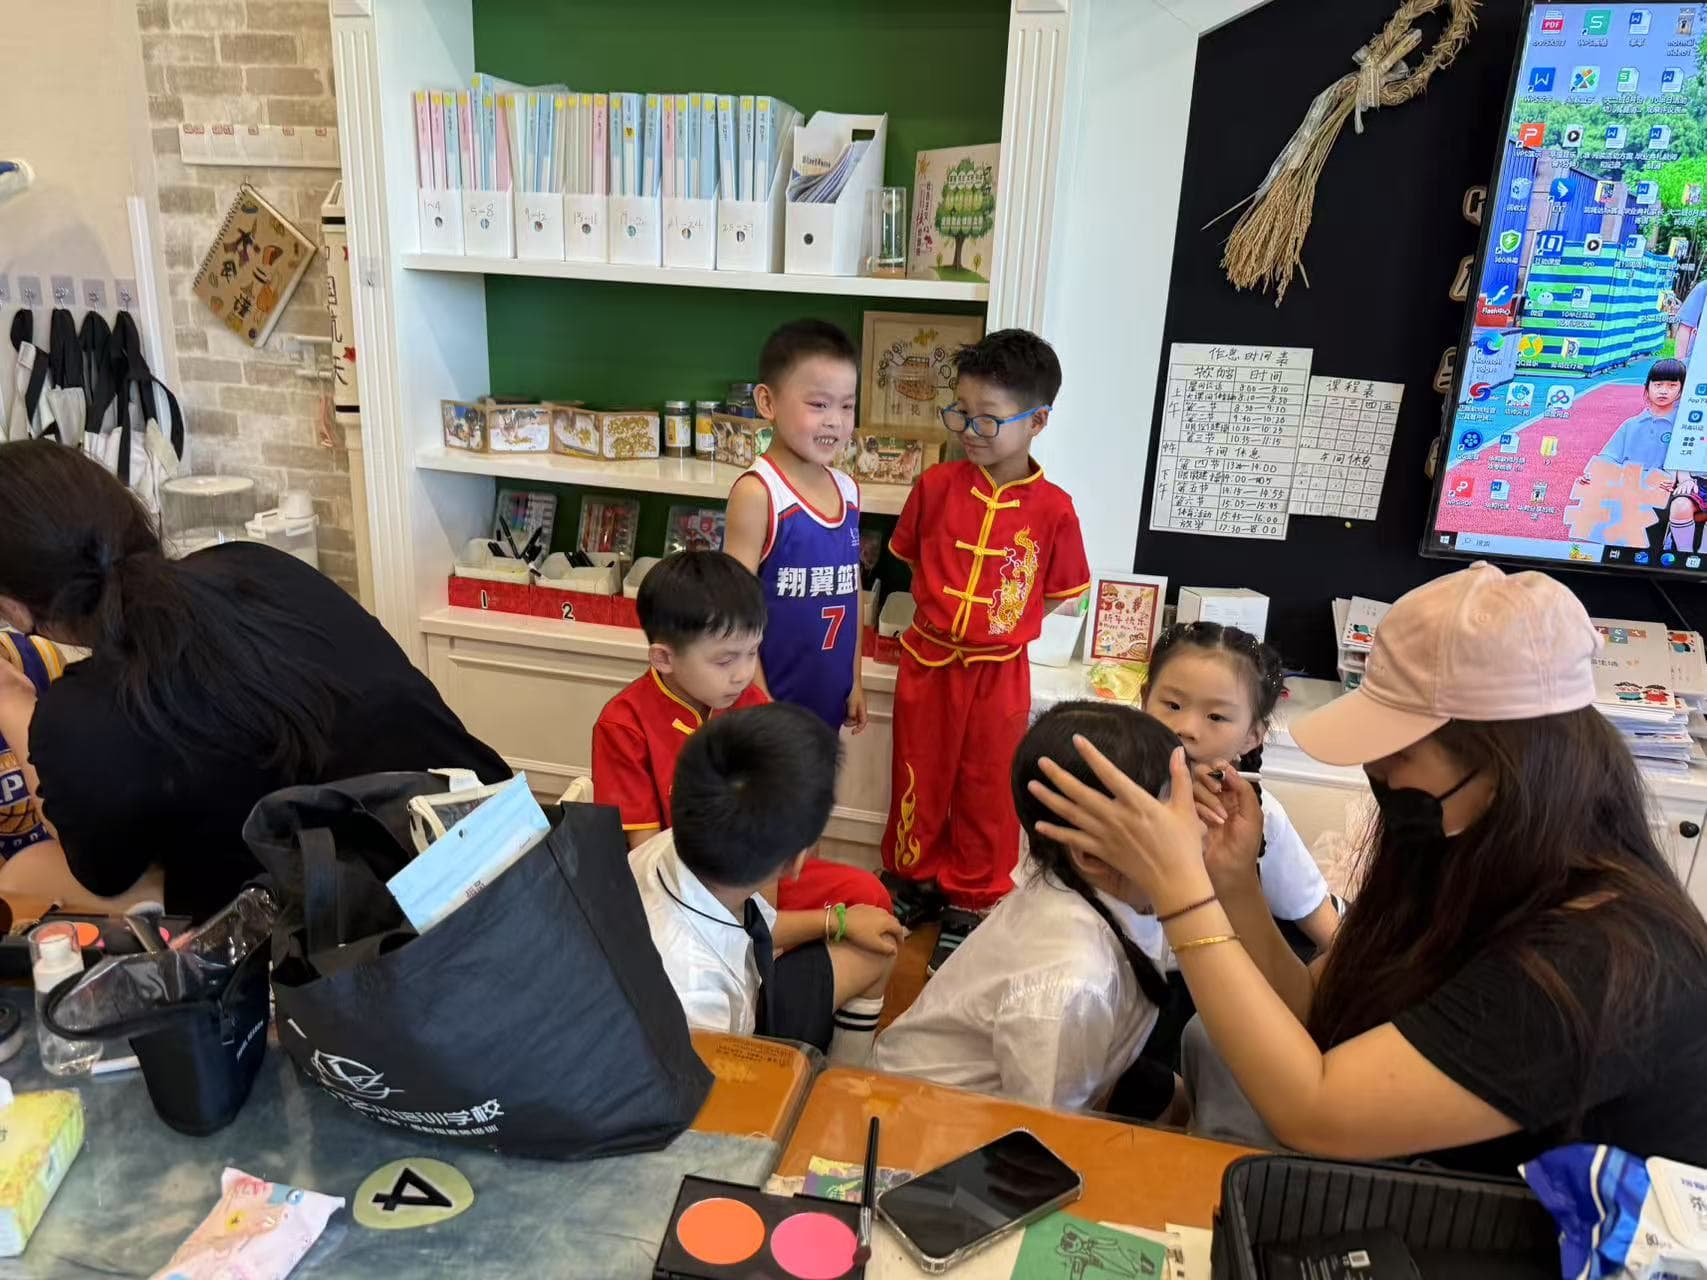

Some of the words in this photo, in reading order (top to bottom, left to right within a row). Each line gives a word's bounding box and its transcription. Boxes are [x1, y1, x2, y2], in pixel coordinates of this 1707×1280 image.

[1544, 21, 1560, 29] PDF
[1209, 347, 1289, 367] 作息时间表
[1249, 369, 1283, 382] 时间
[1326, 379, 1375, 399] 课程表
[1204, 445, 1261, 460] 午间休息
[562, 602, 575, 620] 2
[821, 605, 846, 650] 7
[1, 775, 25, 802] P
[372, 1167, 453, 1212] 4
